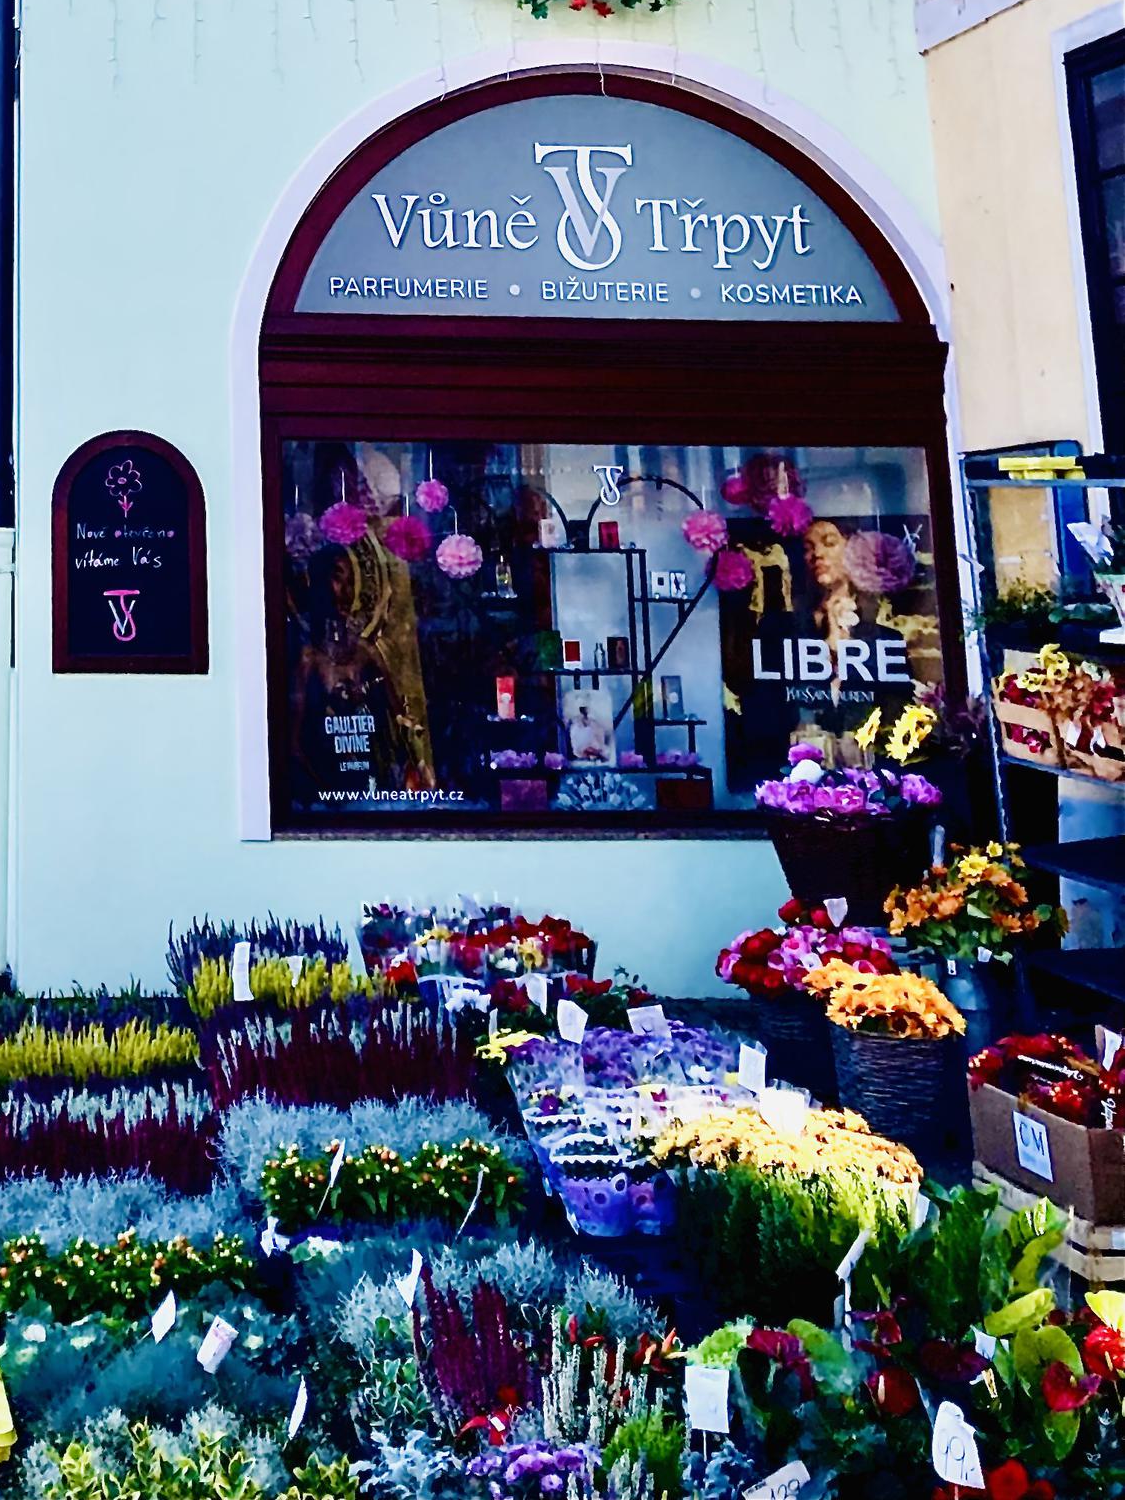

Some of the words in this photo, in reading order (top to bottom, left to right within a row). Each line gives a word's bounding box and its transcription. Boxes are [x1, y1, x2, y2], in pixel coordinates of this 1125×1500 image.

[371, 192, 539, 250] Vůně
[635, 197, 811, 270] Třpyt
[330, 276, 488, 299] PARFUMERIE
[542, 276, 669, 302] BIŽUTERIE
[721, 283, 863, 304] KOSMETIKA
[75, 549, 119, 569] vítáme
[132, 546, 162, 568] Vás
[752, 638, 911, 682] LIBRE
[325, 715, 375, 734] GAULTIER
[335, 735, 371, 753] DIVINE
[318, 788, 464, 803] www.vuneatrpyt.cz
